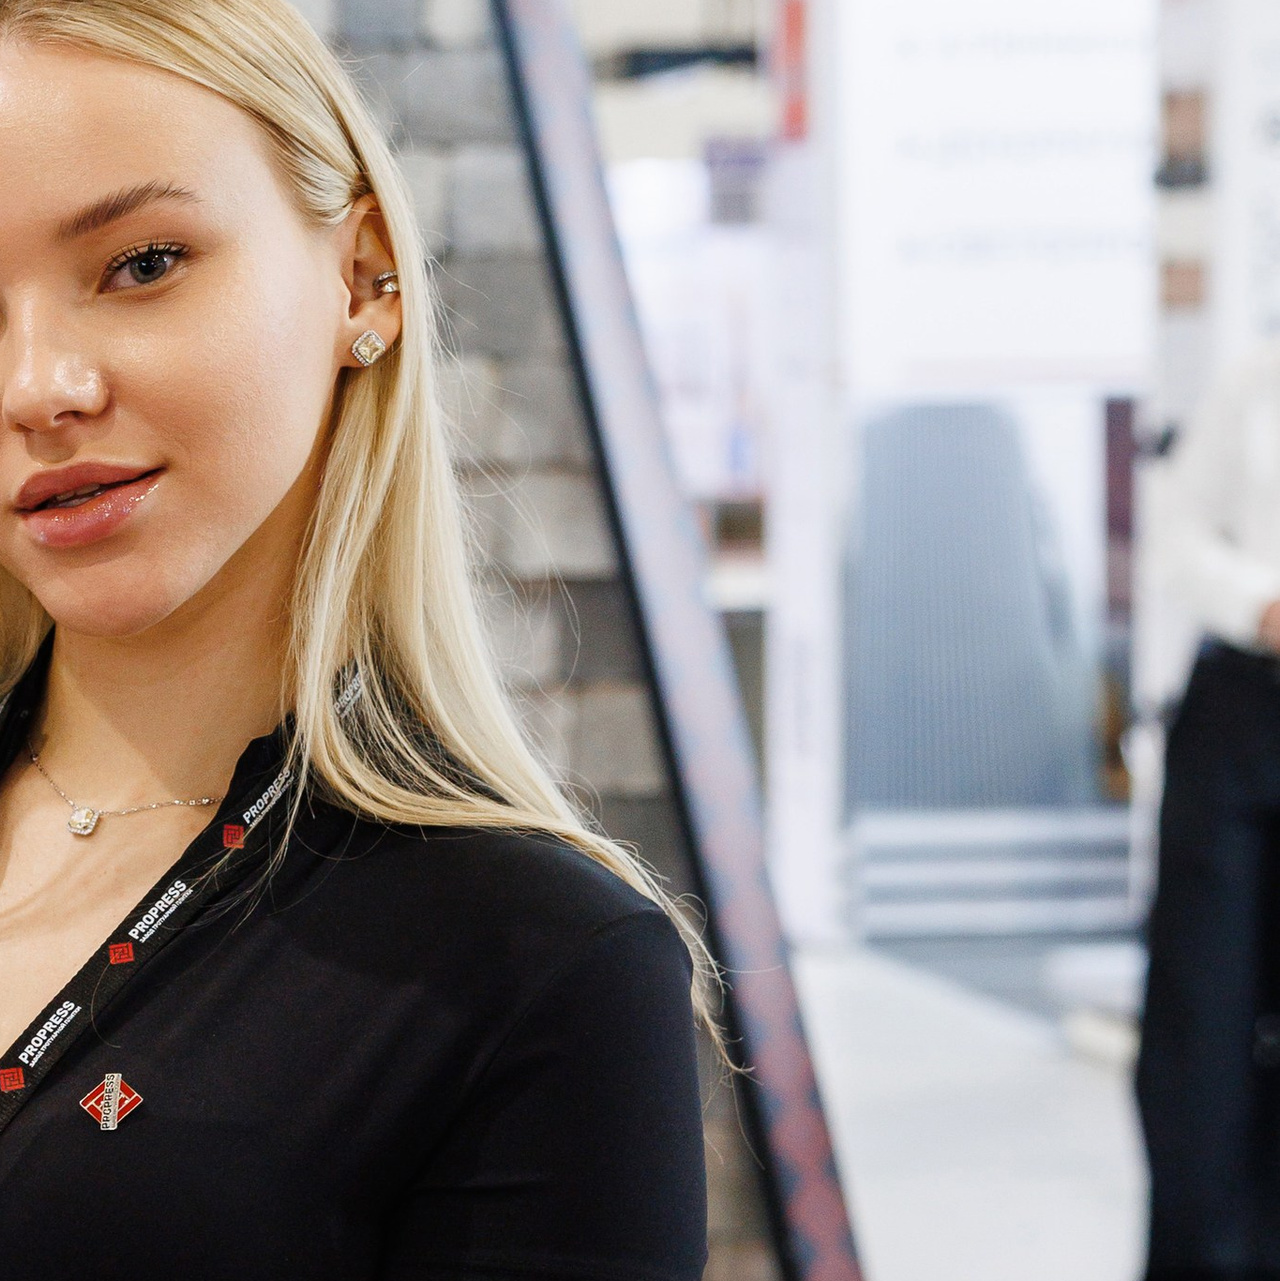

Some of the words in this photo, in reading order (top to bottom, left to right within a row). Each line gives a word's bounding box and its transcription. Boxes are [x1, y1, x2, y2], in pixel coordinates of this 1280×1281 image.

[128, 880, 186, 939] PROPRESS
[18, 1001, 75, 1064] PROPRESS
[101, 1074, 115, 1129] PROPRESS
